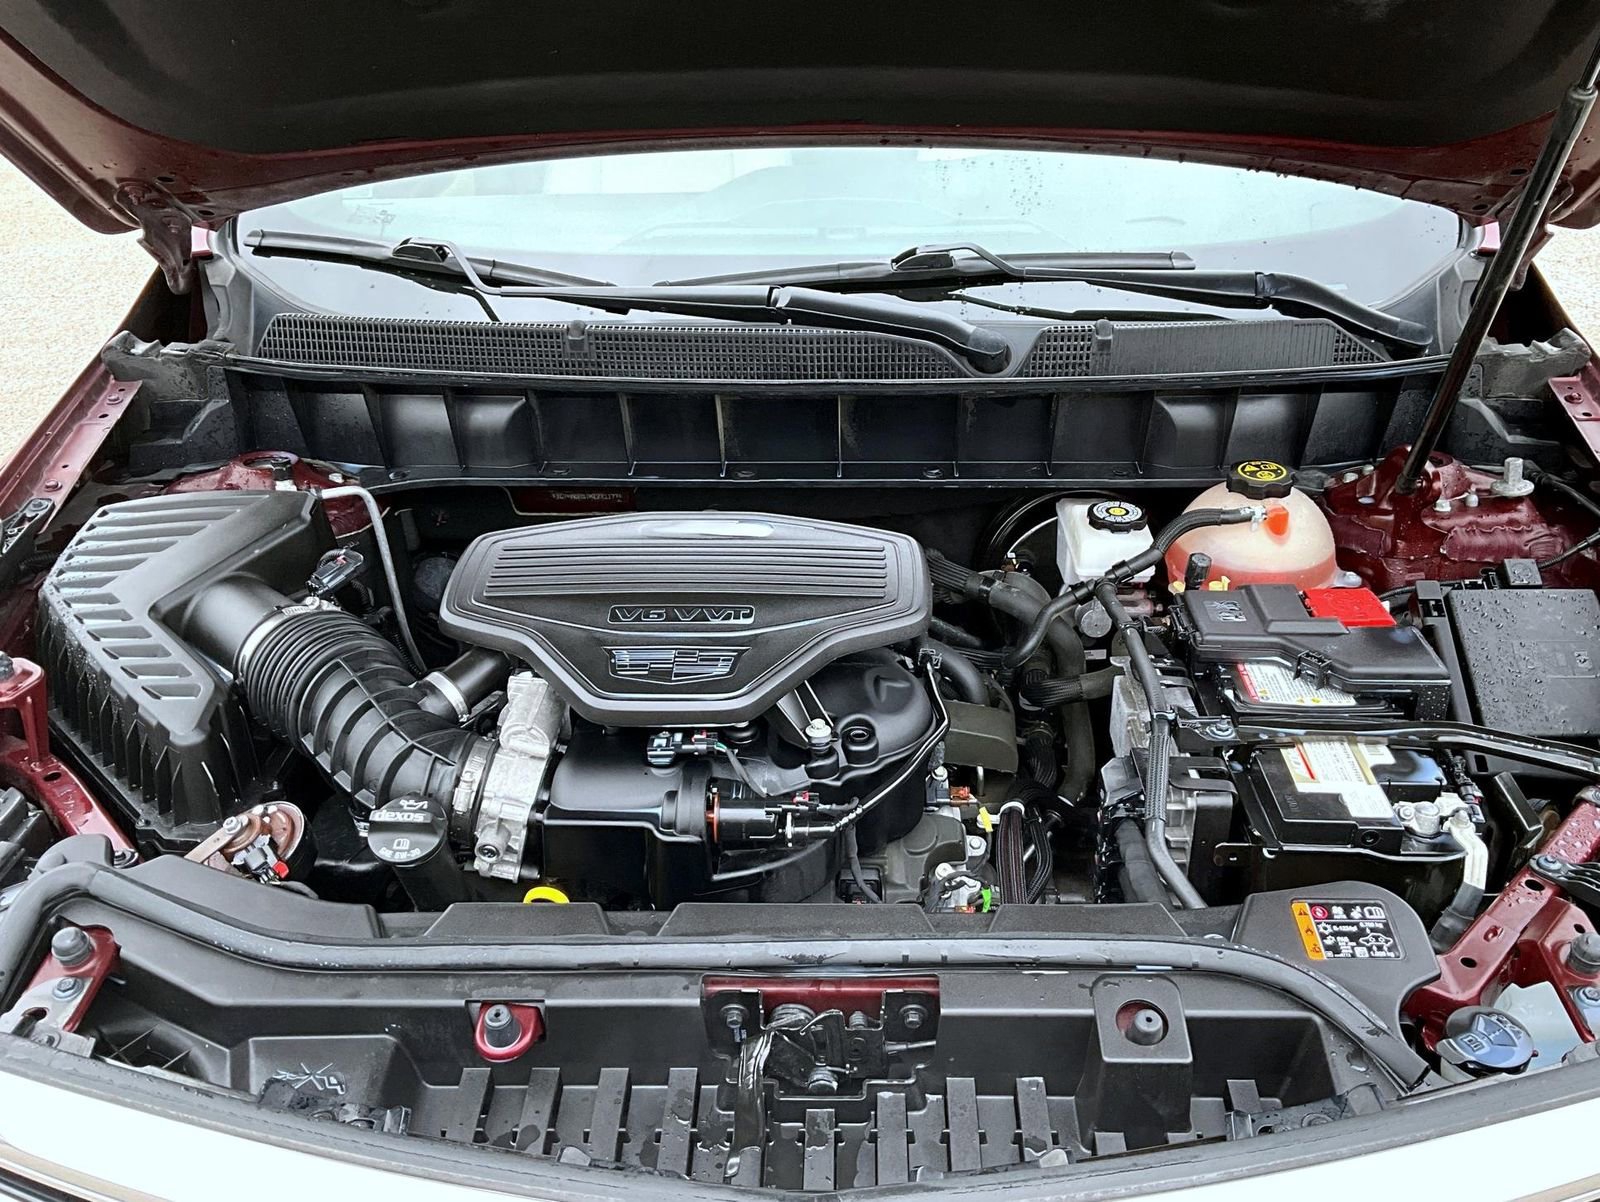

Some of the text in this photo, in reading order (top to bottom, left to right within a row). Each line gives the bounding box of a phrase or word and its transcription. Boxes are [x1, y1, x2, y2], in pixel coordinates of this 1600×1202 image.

[615, 608, 751, 622] V6 VVT
[374, 809, 425, 821] dexos
